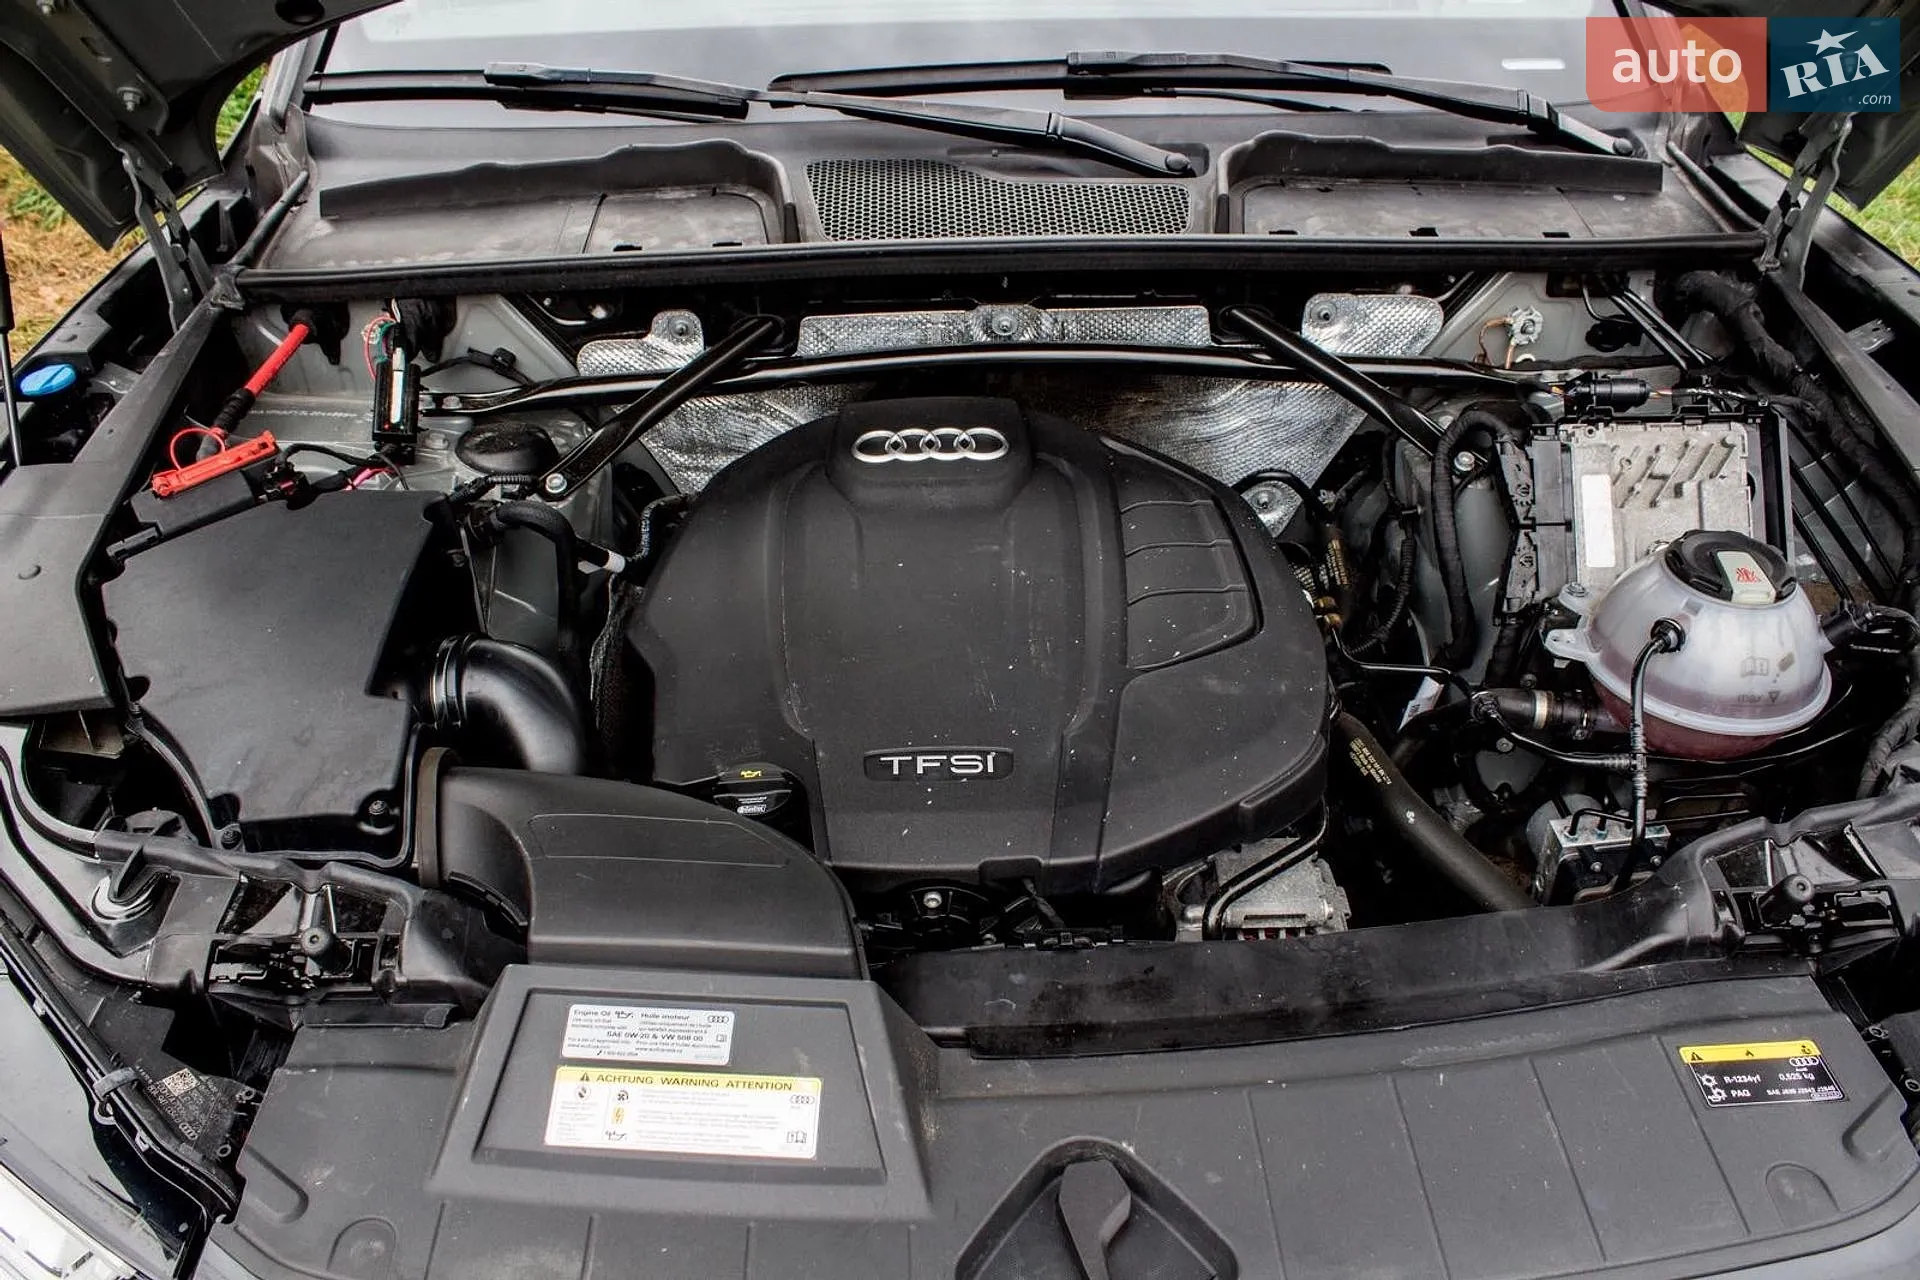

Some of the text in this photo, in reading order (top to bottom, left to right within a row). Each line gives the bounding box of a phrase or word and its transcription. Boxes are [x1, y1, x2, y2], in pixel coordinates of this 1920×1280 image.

[880, 752, 996, 775] TFSI
[596, 1074, 793, 1091] ACHTUNG WARNING ATTENTION
